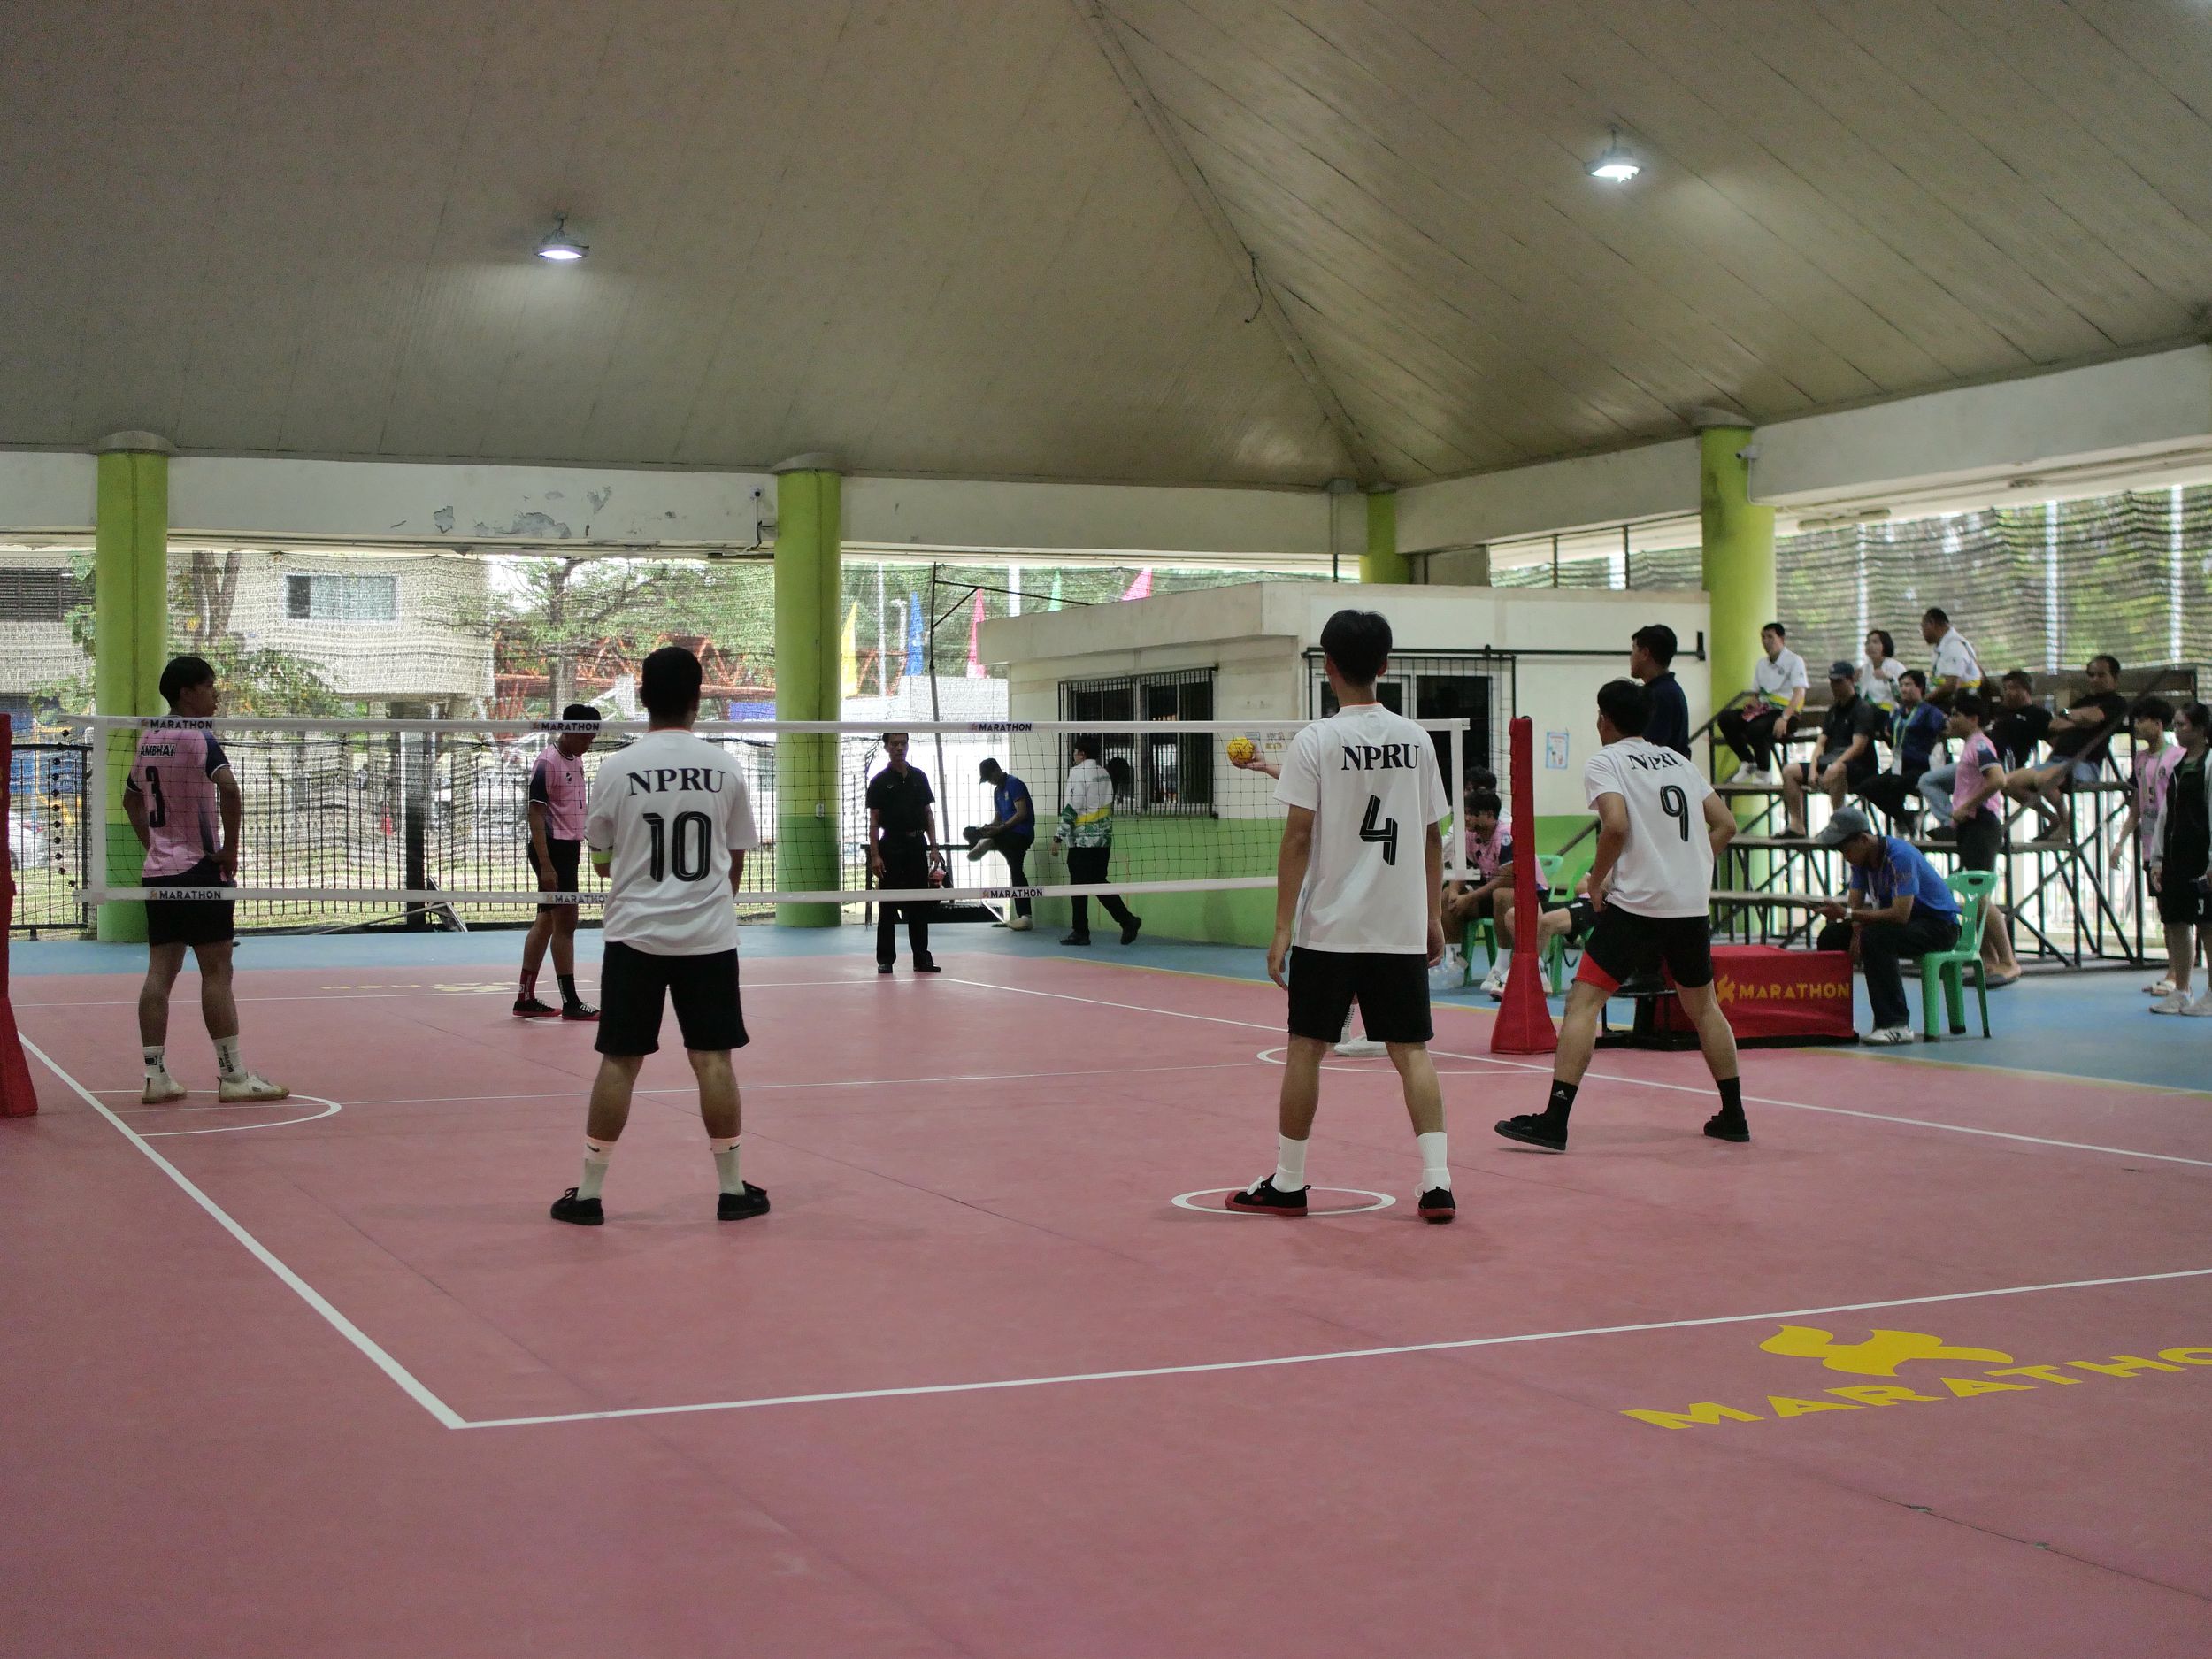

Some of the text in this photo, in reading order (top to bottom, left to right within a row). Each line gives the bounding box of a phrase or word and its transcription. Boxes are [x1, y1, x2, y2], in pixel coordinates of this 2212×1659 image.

[150, 719, 212, 729] MARATHON
[541, 722, 600, 731] MARATHON
[979, 723, 1032, 732] MARATHON
[1341, 743, 1419, 771] NPRU
[626, 768, 726, 796] NPRU
[145, 765, 166, 828] 3
[1660, 785, 1689, 842] 9
[1359, 795, 1398, 865] 4
[642, 810, 712, 883] 10
[159, 890, 221, 900] MARATHON
[555, 895, 608, 903] MARATHO
[990, 888, 1042, 898] MARATHON
[1739, 983, 1850, 999] MARATHON
